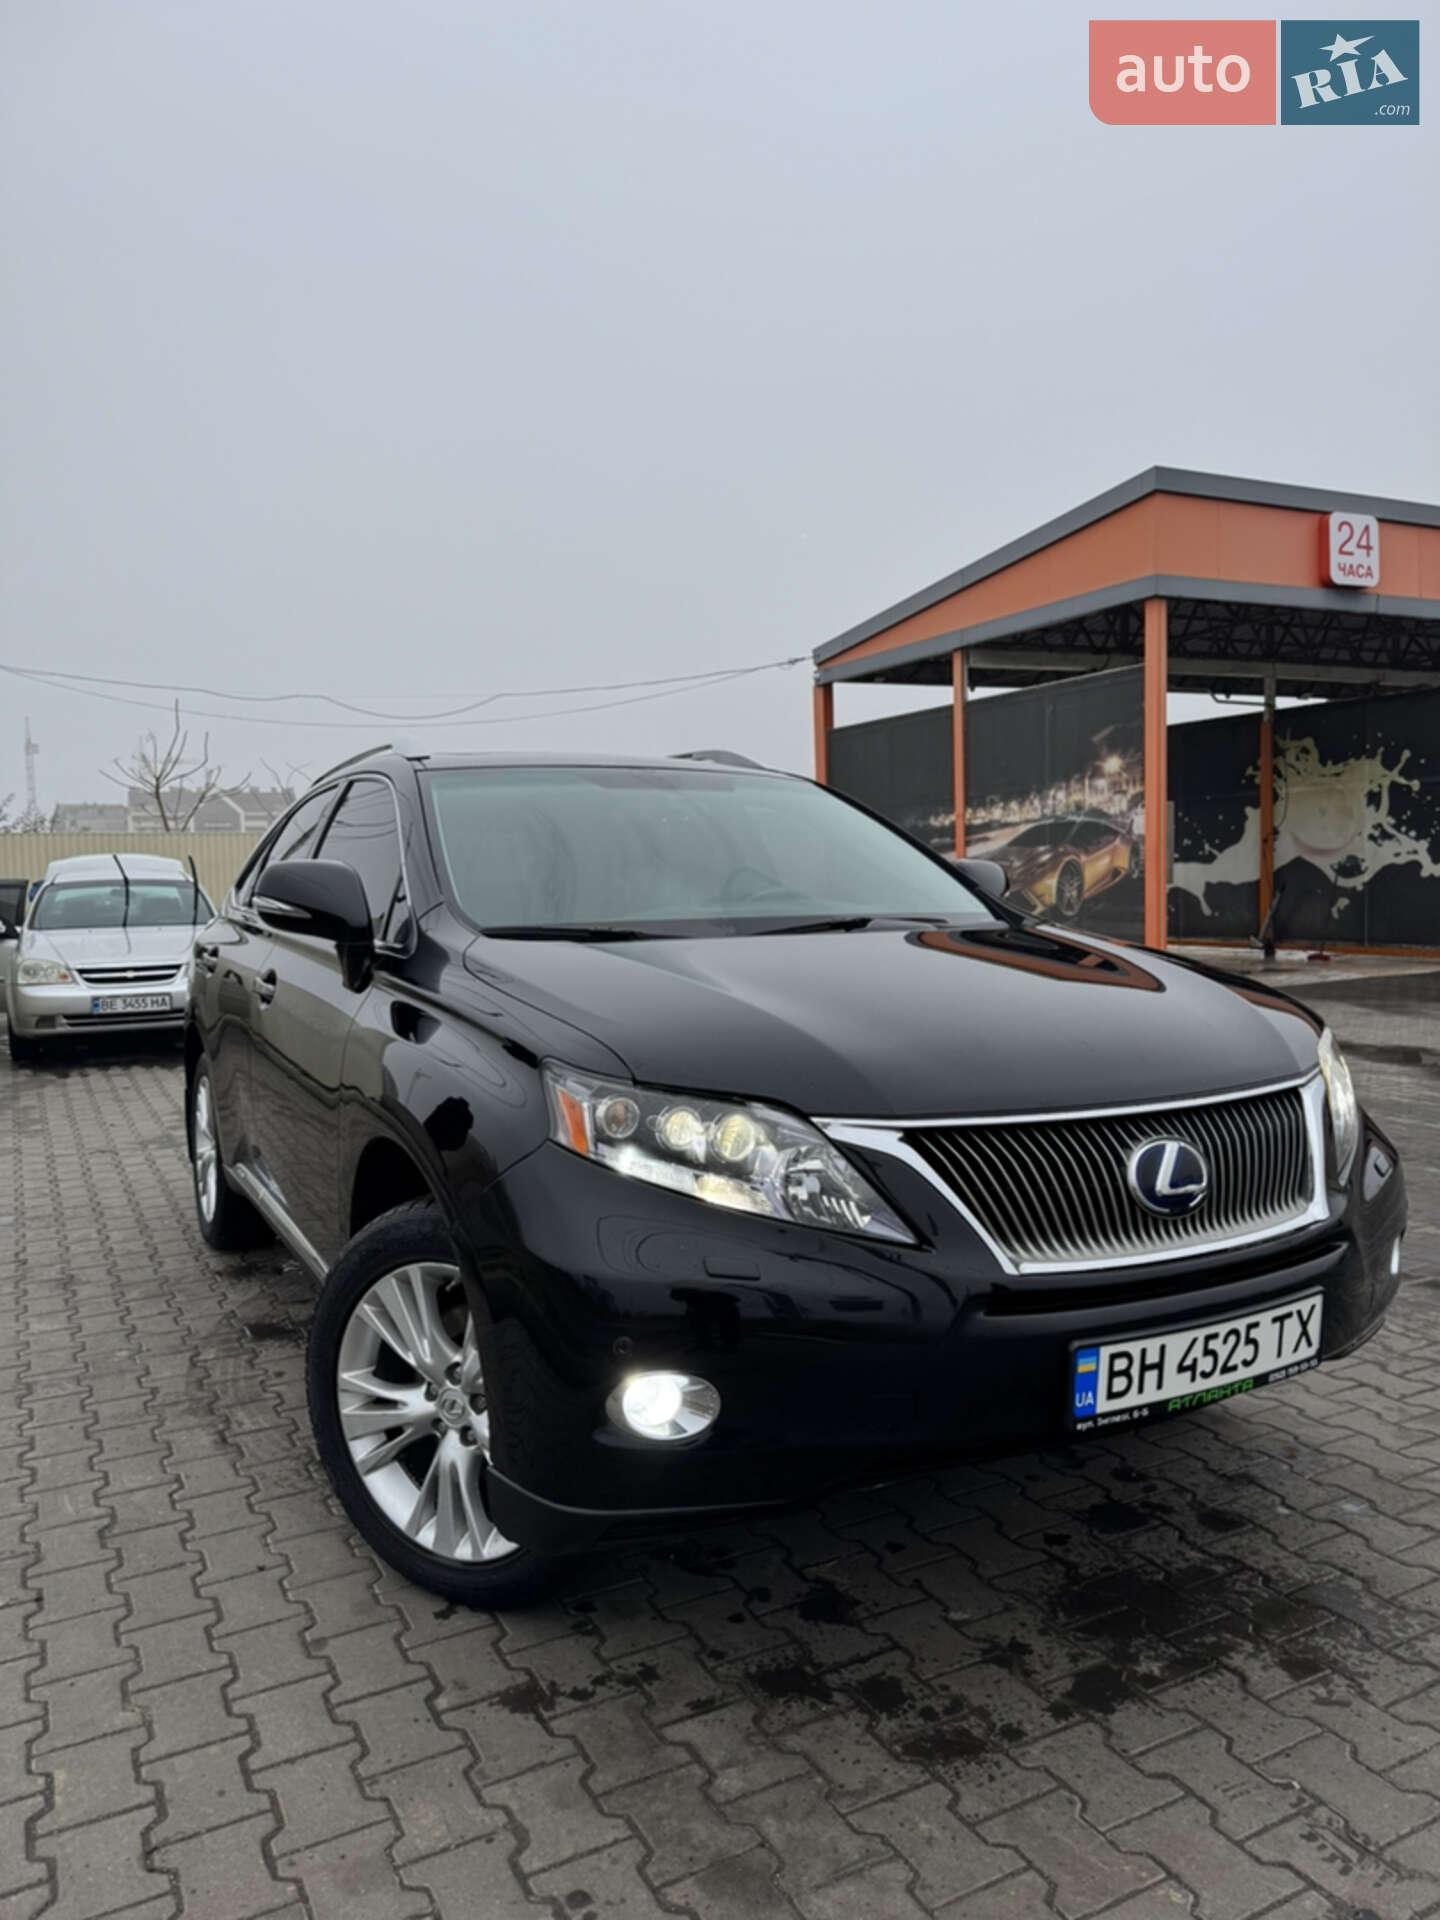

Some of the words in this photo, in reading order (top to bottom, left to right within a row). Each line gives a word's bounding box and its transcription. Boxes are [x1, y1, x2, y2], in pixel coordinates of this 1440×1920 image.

[1337, 520, 1373, 558] 24
[1337, 562, 1374, 579] ЧАСА
[151, 996, 168, 1008] HA
[1106, 1343, 1166, 1401] BH
[1176, 1321, 1260, 1383] 4525
[1271, 1303, 1316, 1359] TX
[1075, 1391, 1095, 1408] UA
